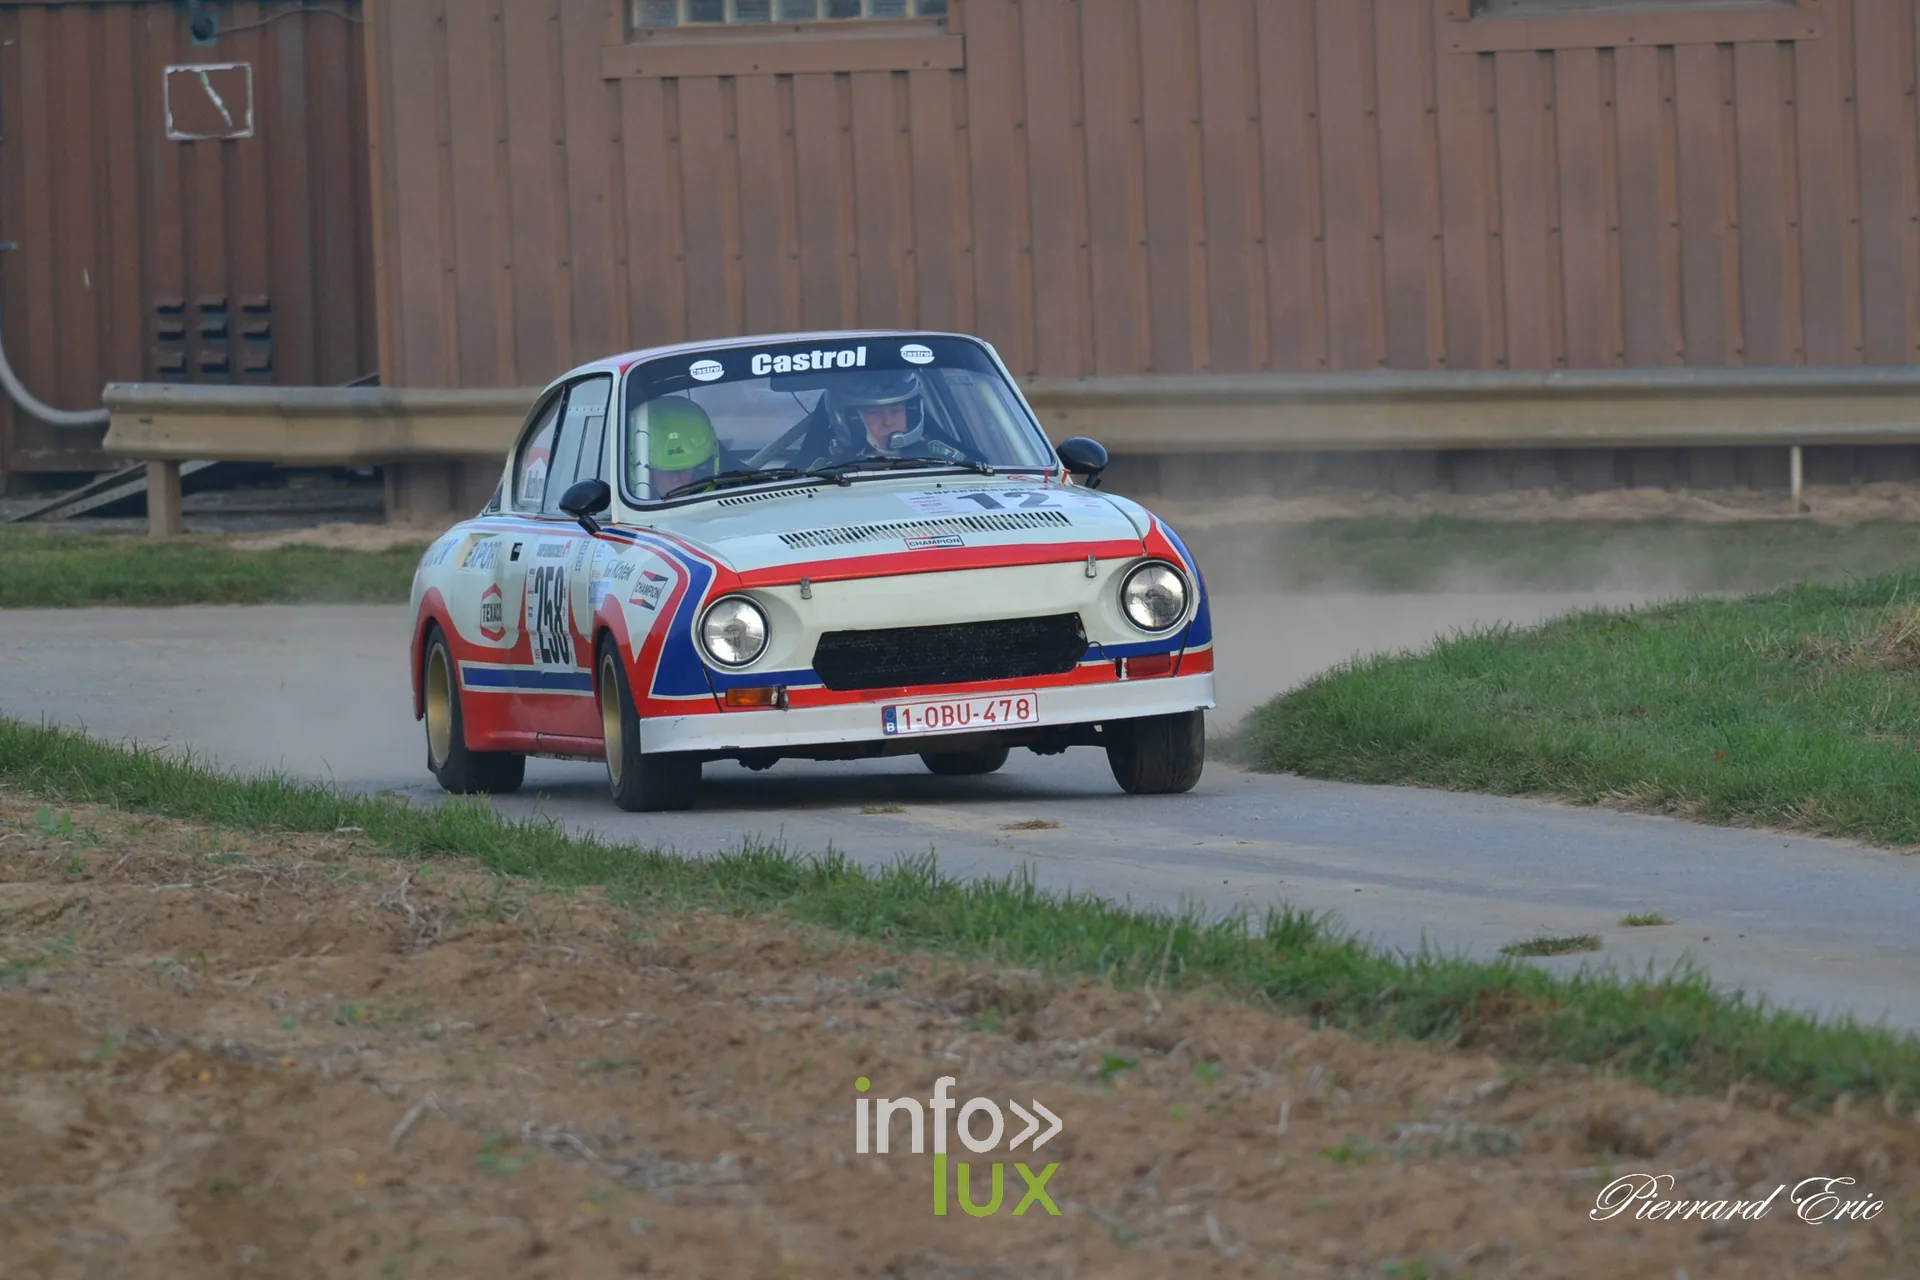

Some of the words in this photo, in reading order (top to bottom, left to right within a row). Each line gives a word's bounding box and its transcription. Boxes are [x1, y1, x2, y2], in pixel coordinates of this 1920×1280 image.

[751, 346, 867, 376] Castrol
[901, 350, 933, 358] Castrol
[690, 365, 723, 377] Castrol
[956, 491, 1063, 510] 12
[908, 537, 960, 548] CHAMPION
[634, 582, 662, 599] CHAMPION
[534, 565, 570, 666] 258
[886, 722, 895, 733] B
[902, 698, 1030, 730] 1-OBU-478
